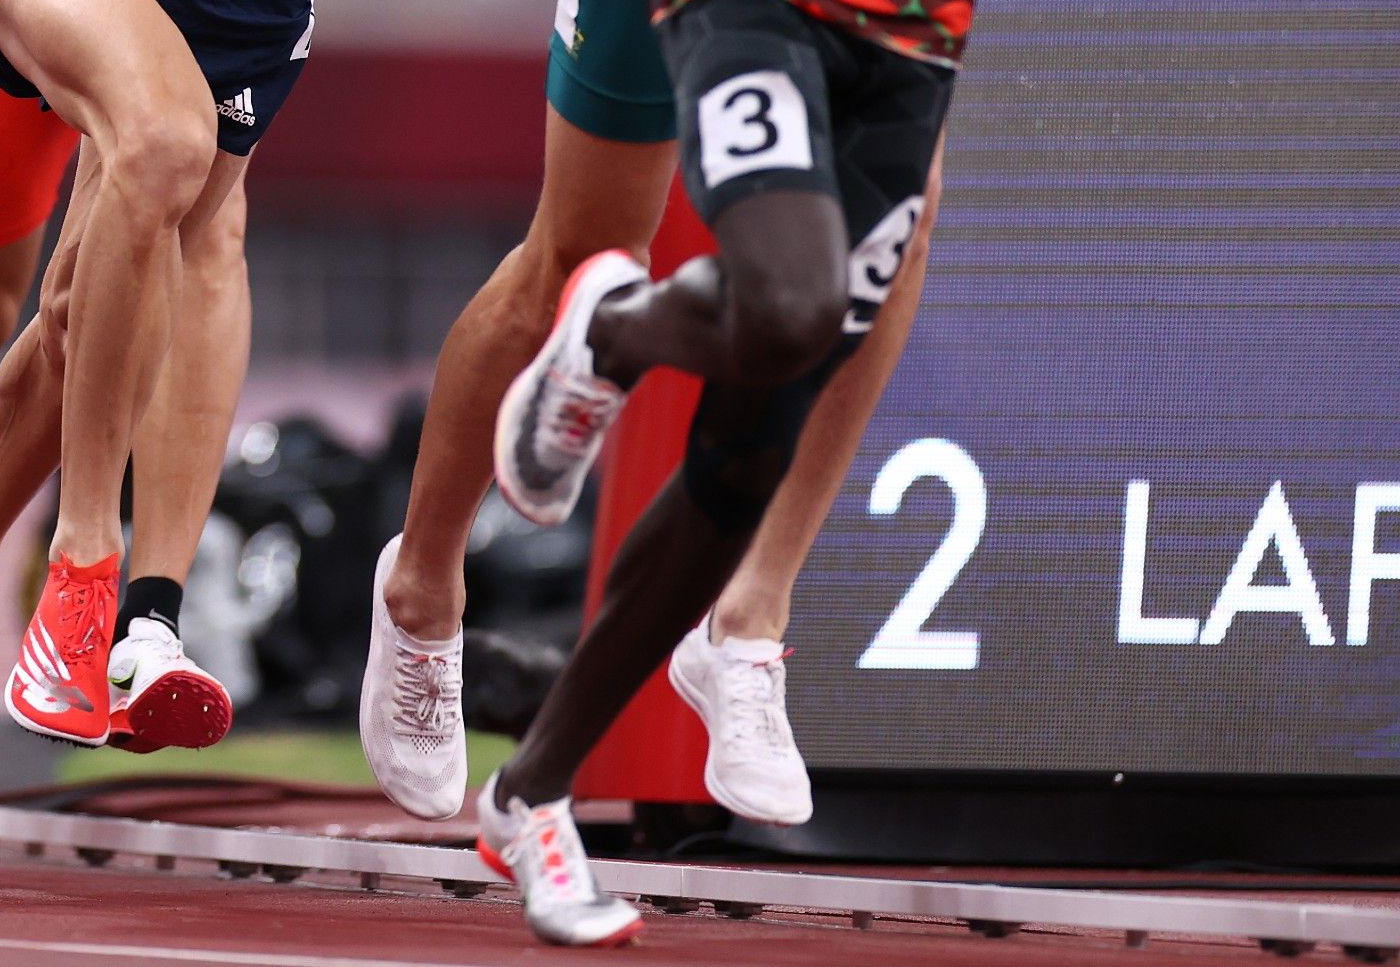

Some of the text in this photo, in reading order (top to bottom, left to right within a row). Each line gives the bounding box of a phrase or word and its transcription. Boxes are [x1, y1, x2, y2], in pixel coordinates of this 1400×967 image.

[216, 104, 256, 126] adidas
[722, 88, 779, 158] 3
[855, 437, 1400, 669] 2 LAP
